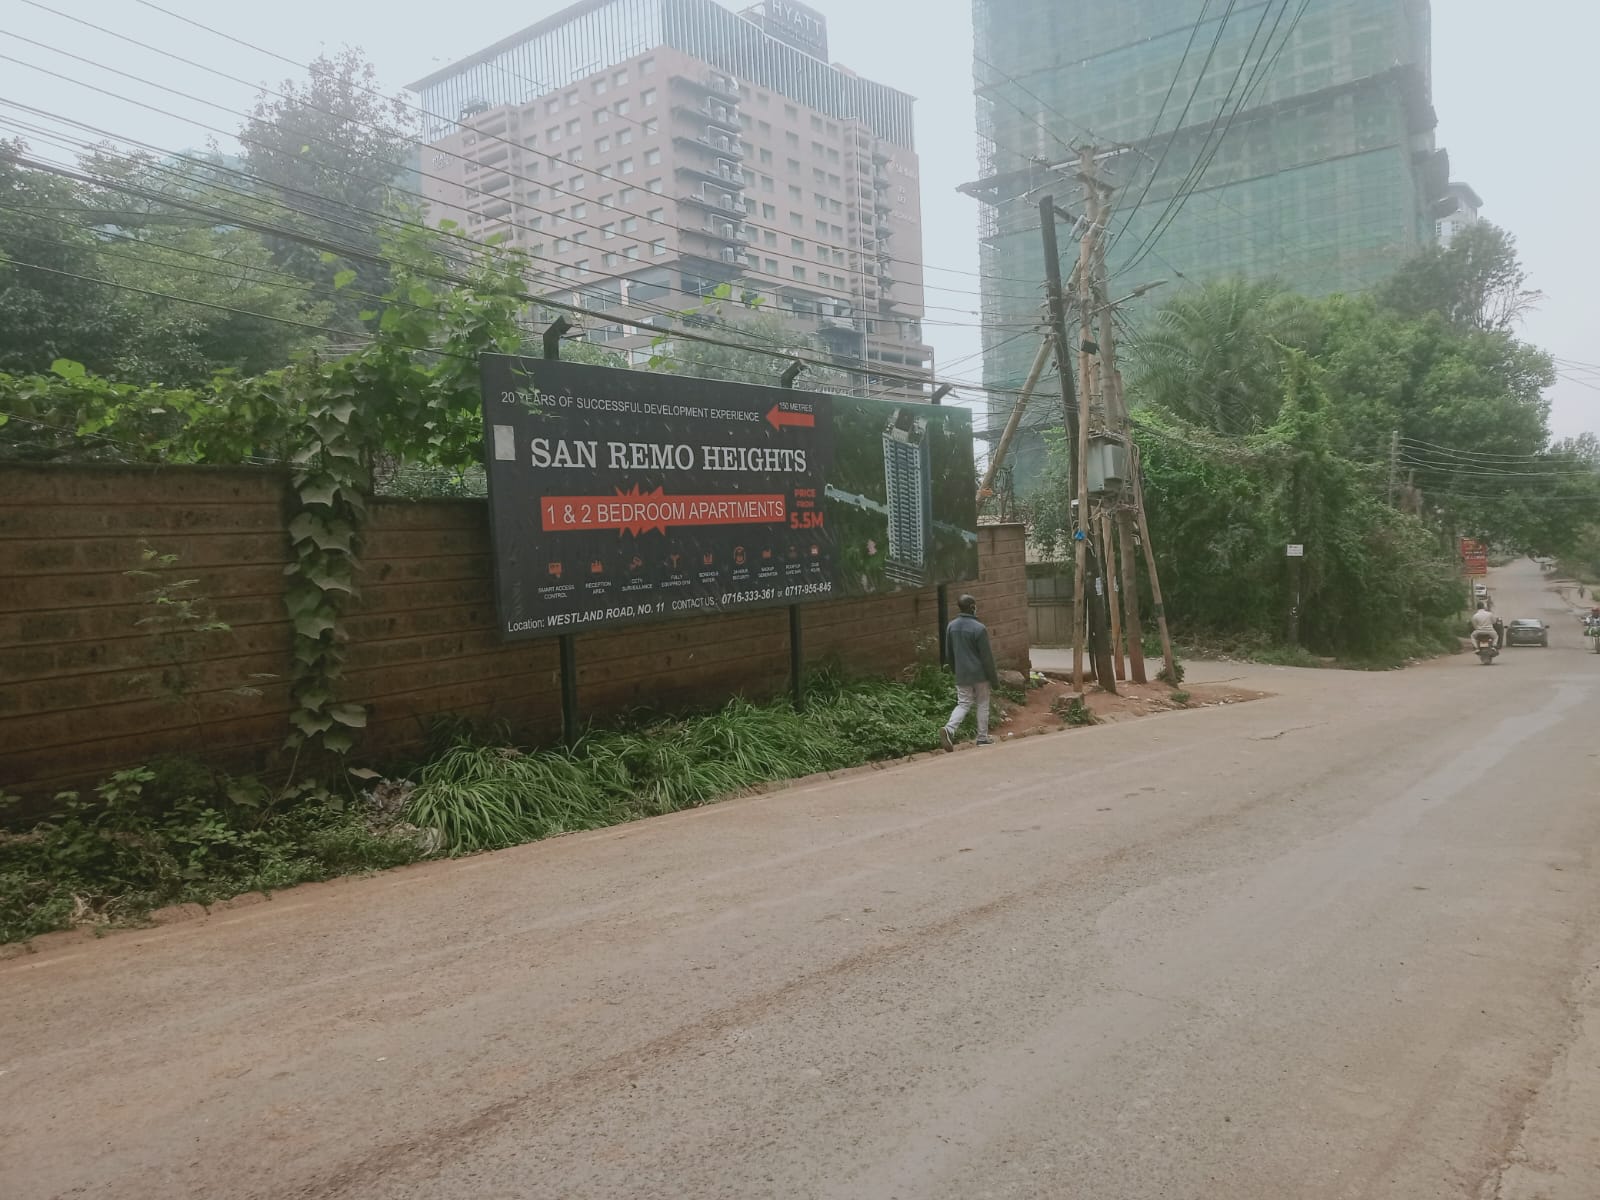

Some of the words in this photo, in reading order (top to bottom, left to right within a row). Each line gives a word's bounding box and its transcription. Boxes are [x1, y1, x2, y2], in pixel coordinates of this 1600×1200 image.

[772, 0, 822, 37] HYATT
[501, 391, 515, 403] 20
[558, 395, 574, 408] OF
[576, 397, 643, 413] SUCCESSFUL
[644, 403, 709, 418] DEVELOPMENT
[710, 408, 760, 422] EXPERIENCE
[530, 437, 598, 469] SAN
[607, 441, 695, 471] REMO
[701, 445, 807, 472] HEIGHTS
[793, 488, 817, 498] PRICE
[546, 505, 555, 525] 1
[563, 504, 576, 524] &
[580, 504, 592, 524] 2
[598, 502, 686, 523] BEDROOM
[688, 499, 785, 520] APARTMENTS
[790, 511, 824, 529] 5.5M
[507, 617, 545, 633] Location:
[547, 609, 604, 627] WESTLAND
[605, 605, 636, 620] ROAD,
[637, 603, 654, 615] NO.
[655, 601, 666, 613] 11
[672, 597, 704, 611] CONTACT
[721, 588, 775, 605] 0716-333-361
[784, 581, 832, 597] 0717-955-845
[543, 592, 568, 600] CONTROL
